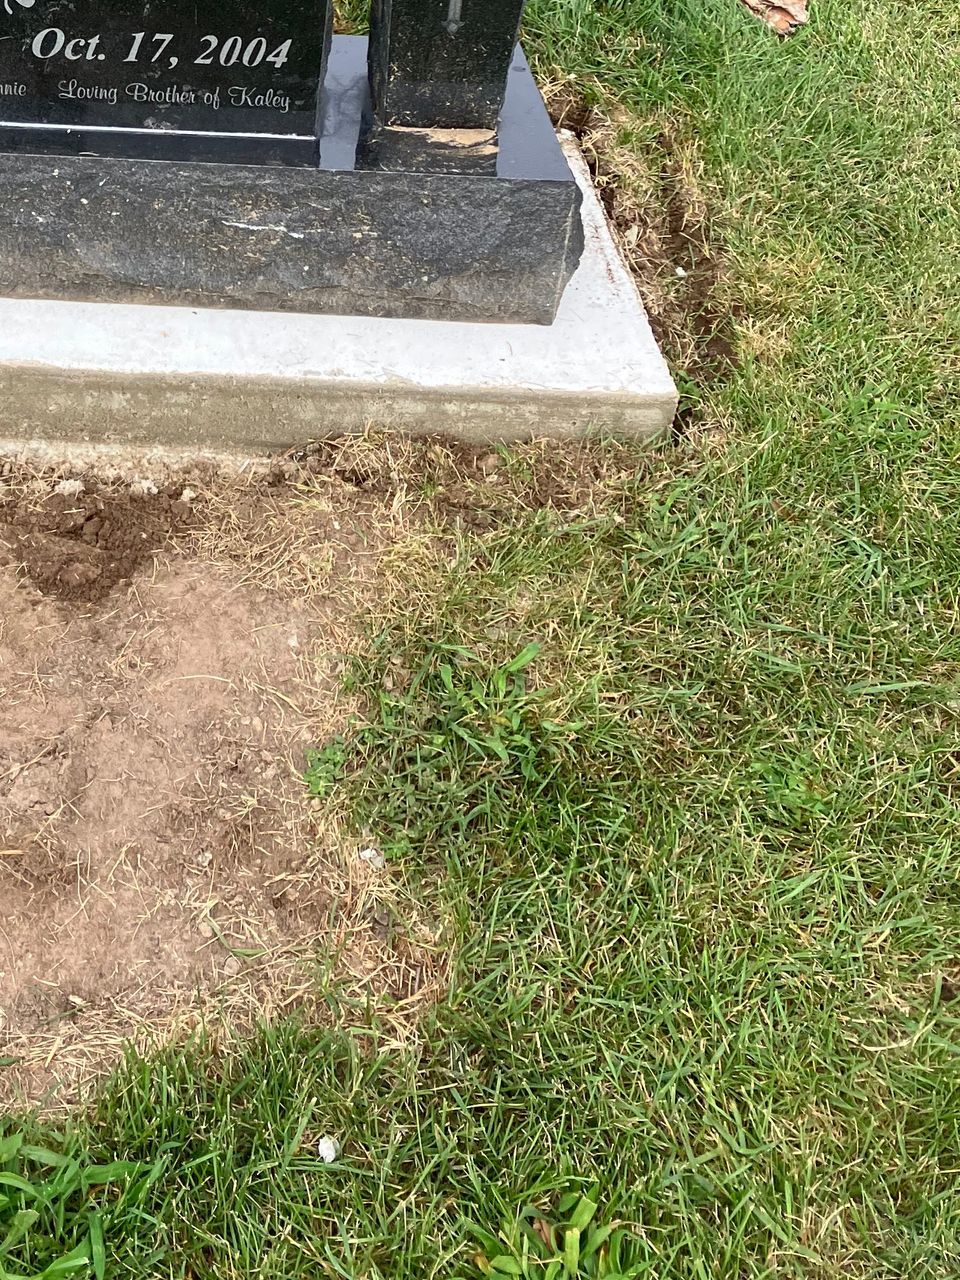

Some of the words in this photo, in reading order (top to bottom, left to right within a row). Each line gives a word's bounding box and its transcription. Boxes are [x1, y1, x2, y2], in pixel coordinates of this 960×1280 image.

[31, 28, 107, 61] Oct.
[123, 31, 180, 69] 17,
[193, 34, 293, 68] 2004
[57, 79, 118, 104] Loving
[125, 82, 196, 104] Brother
[203, 86, 221, 110] of
[227, 85, 290, 113] Kaley
